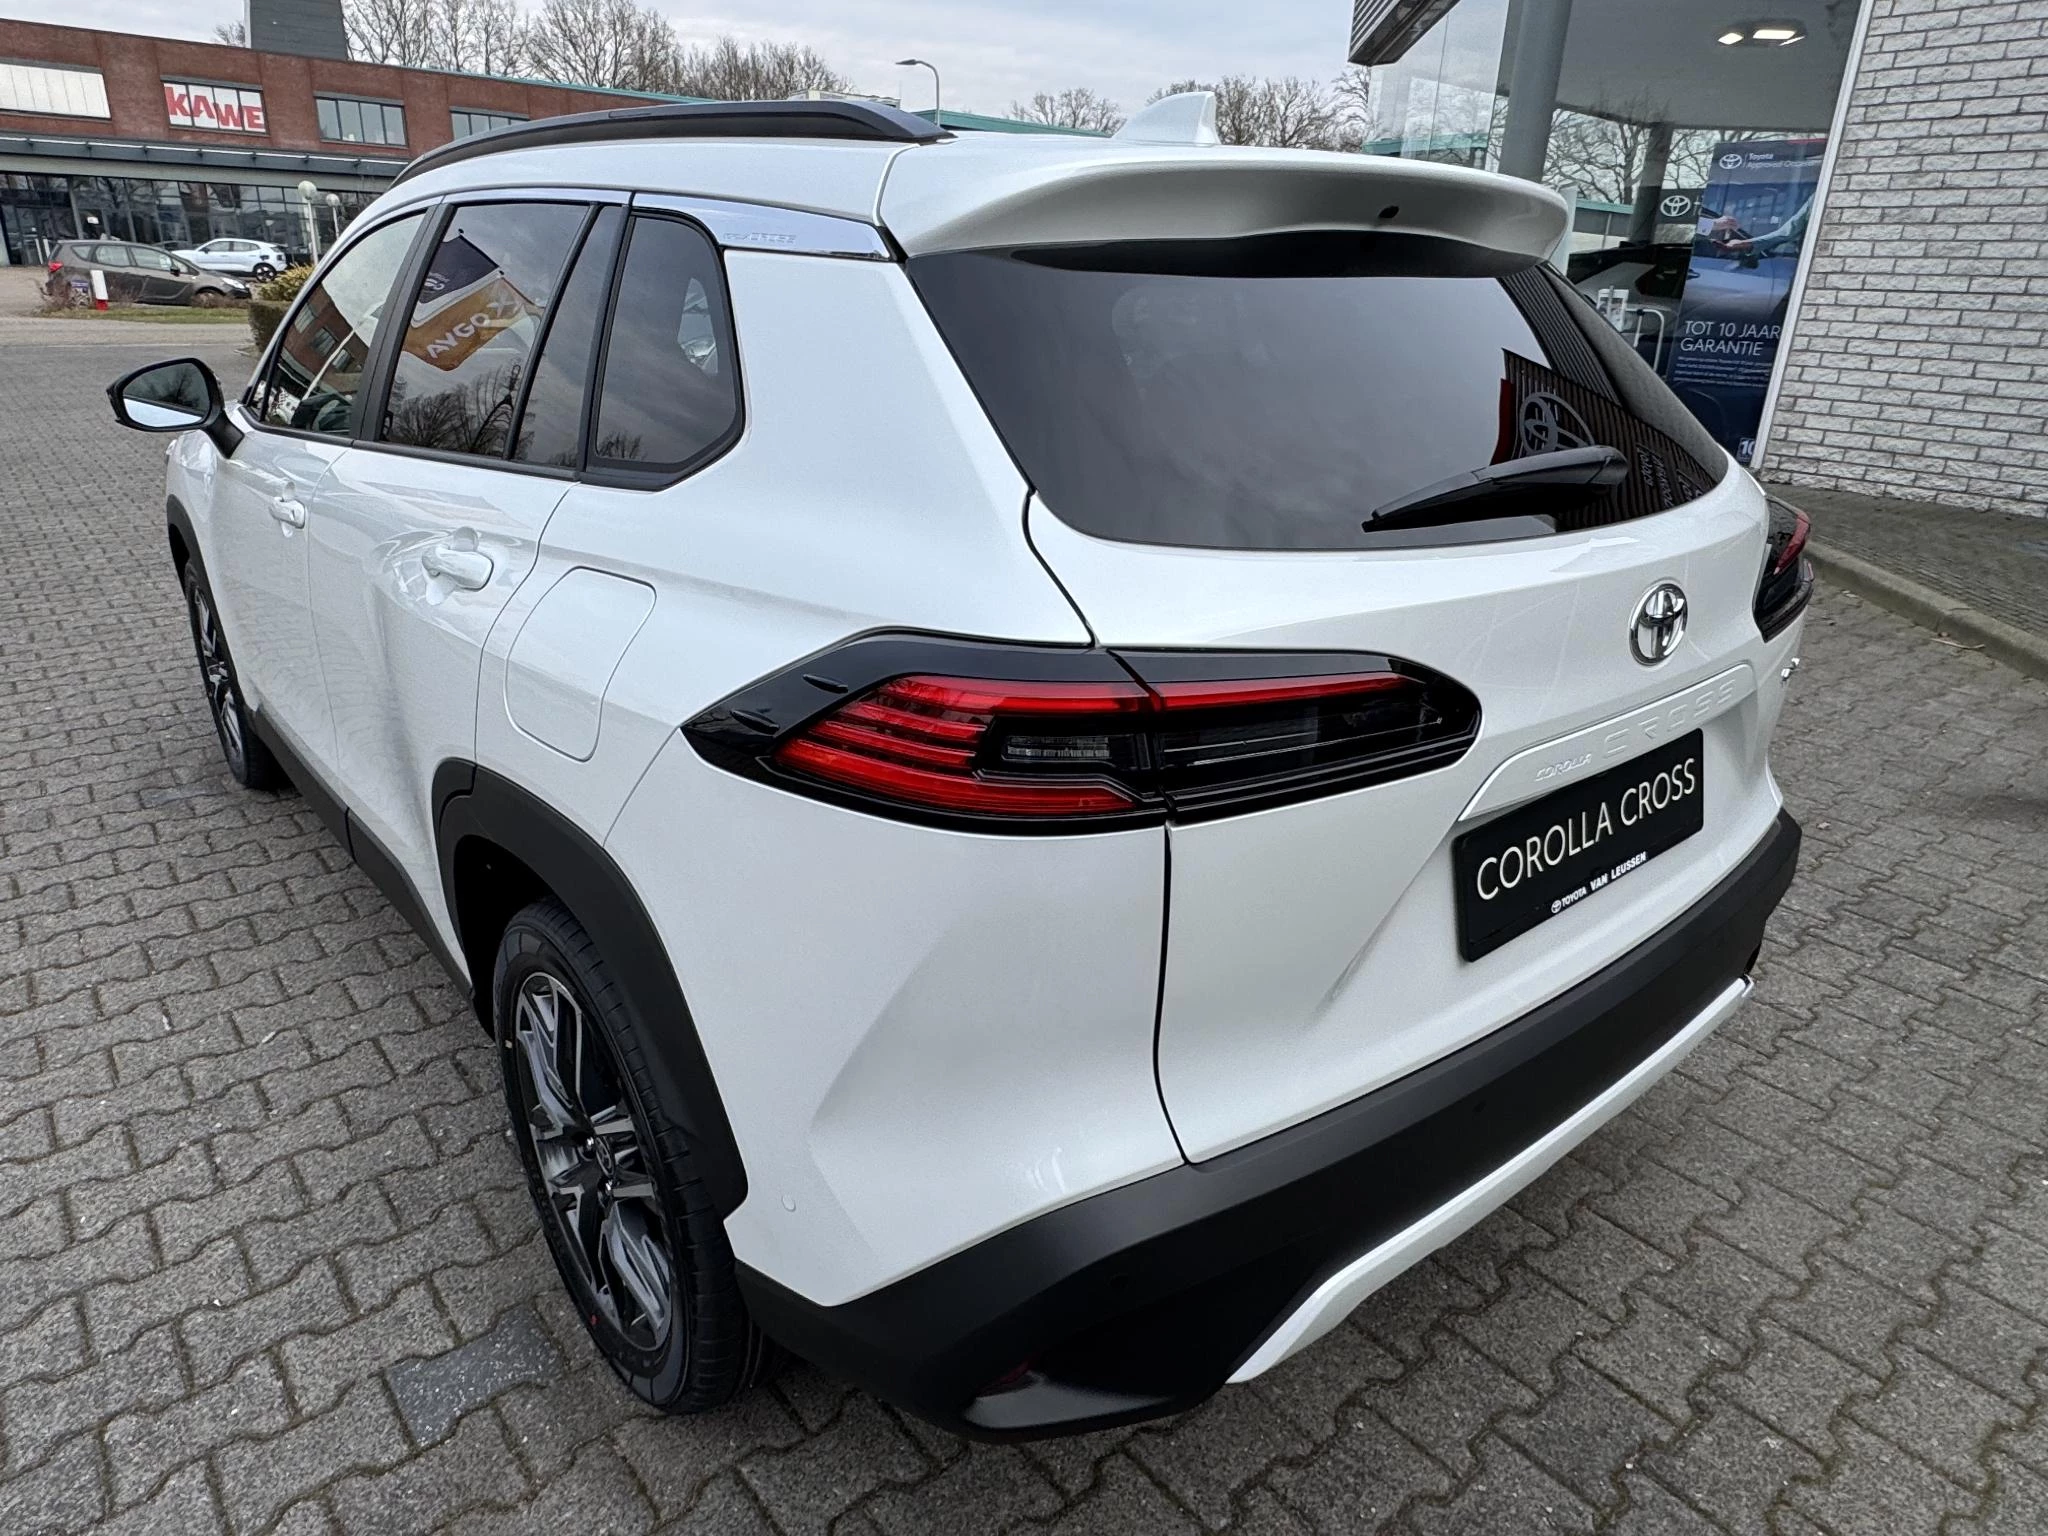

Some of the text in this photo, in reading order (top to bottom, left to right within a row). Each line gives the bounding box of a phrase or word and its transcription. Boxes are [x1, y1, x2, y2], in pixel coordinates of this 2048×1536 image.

[165, 86, 265, 129] KAWE
[1749, 153, 1774, 161] Toyota
[426, 312, 490, 359] AYGO
[1680, 337, 1765, 356] GARANTIE
[1684, 320, 1781, 340] TOT 10 JAAR
[1602, 679, 1736, 759] CROSS
[1476, 758, 1696, 901] COROLLA CROSS
[1561, 851, 1647, 907] TOYOTA VAN LEUSSEN
